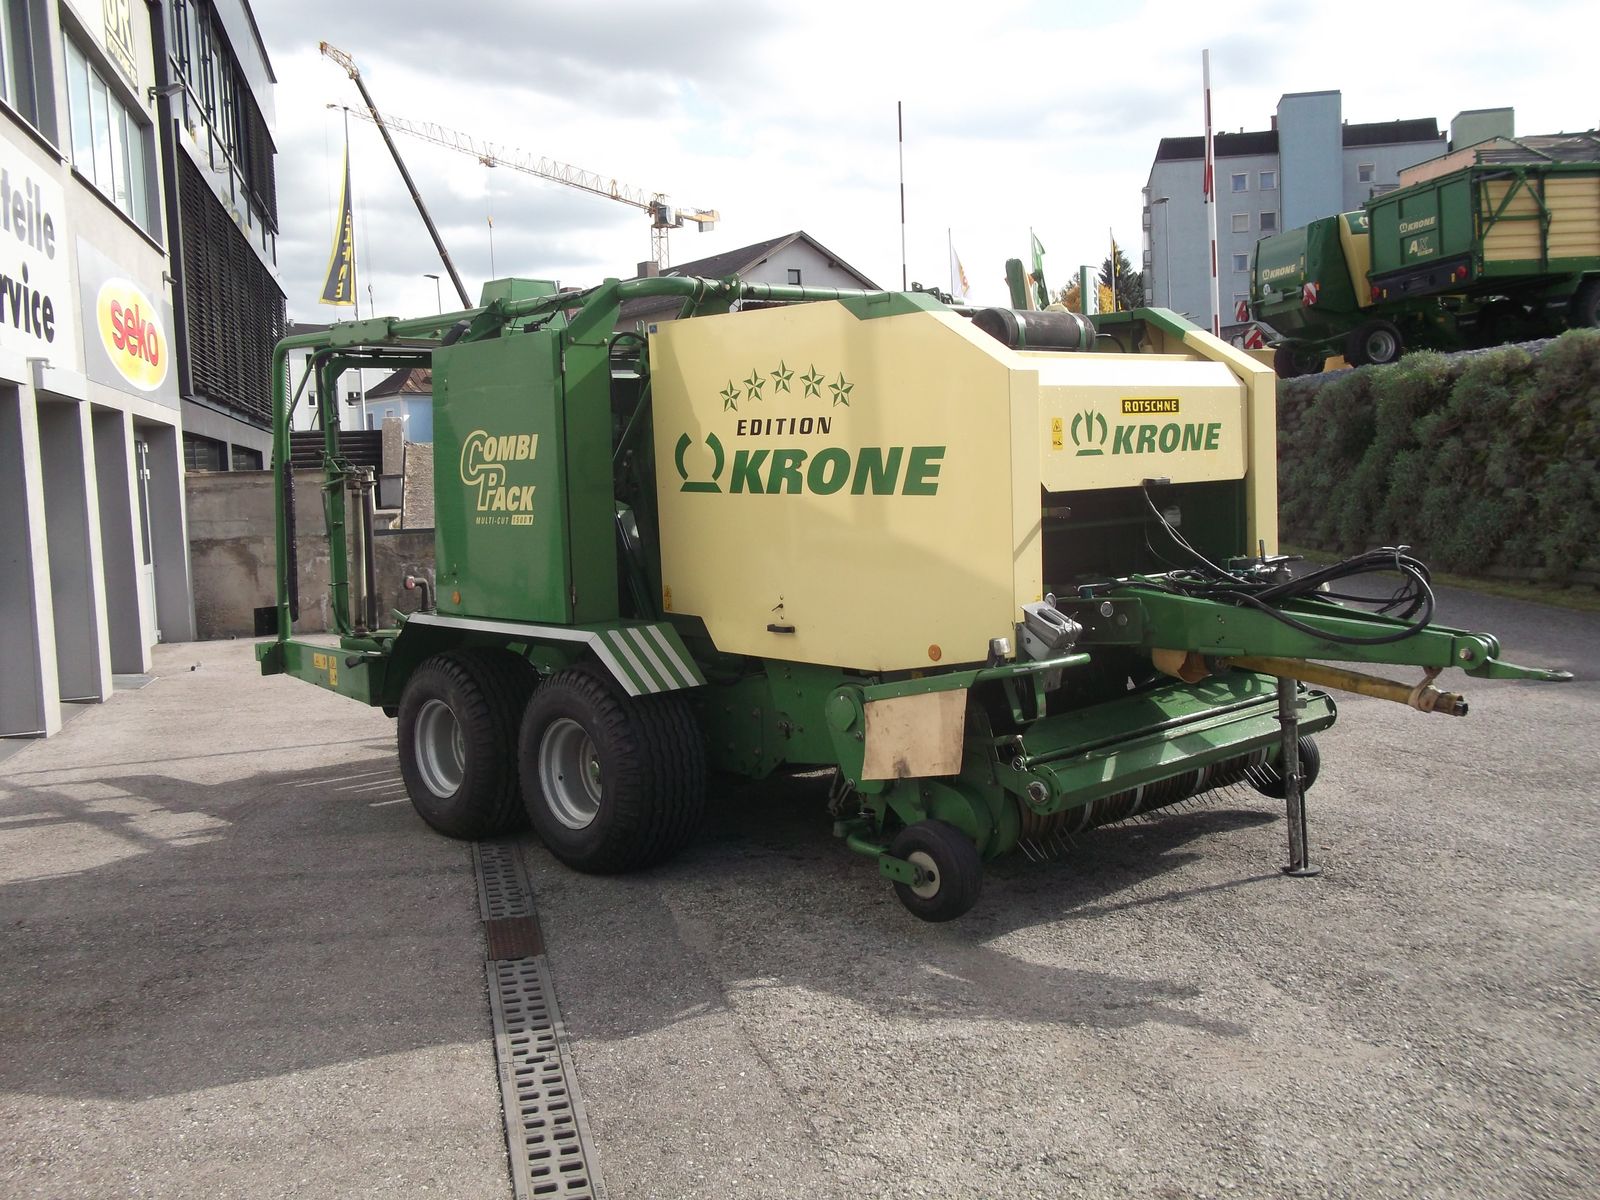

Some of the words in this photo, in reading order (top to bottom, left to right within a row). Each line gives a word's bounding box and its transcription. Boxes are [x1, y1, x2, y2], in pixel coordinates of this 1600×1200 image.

[1408, 216, 1436, 231] KRONE
[1270, 264, 1296, 279] KRONE
[110, 299, 159, 367] seko
[1124, 400, 1177, 412] ROTSCHNE
[736, 416, 832, 436] EDITION
[1112, 422, 1222, 455] KRONE
[460, 429, 539, 486] COMBI
[729, 445, 947, 496] KRONE
[476, 463, 536, 511] PACK
[475, 516, 509, 525] MULTI-CUT
